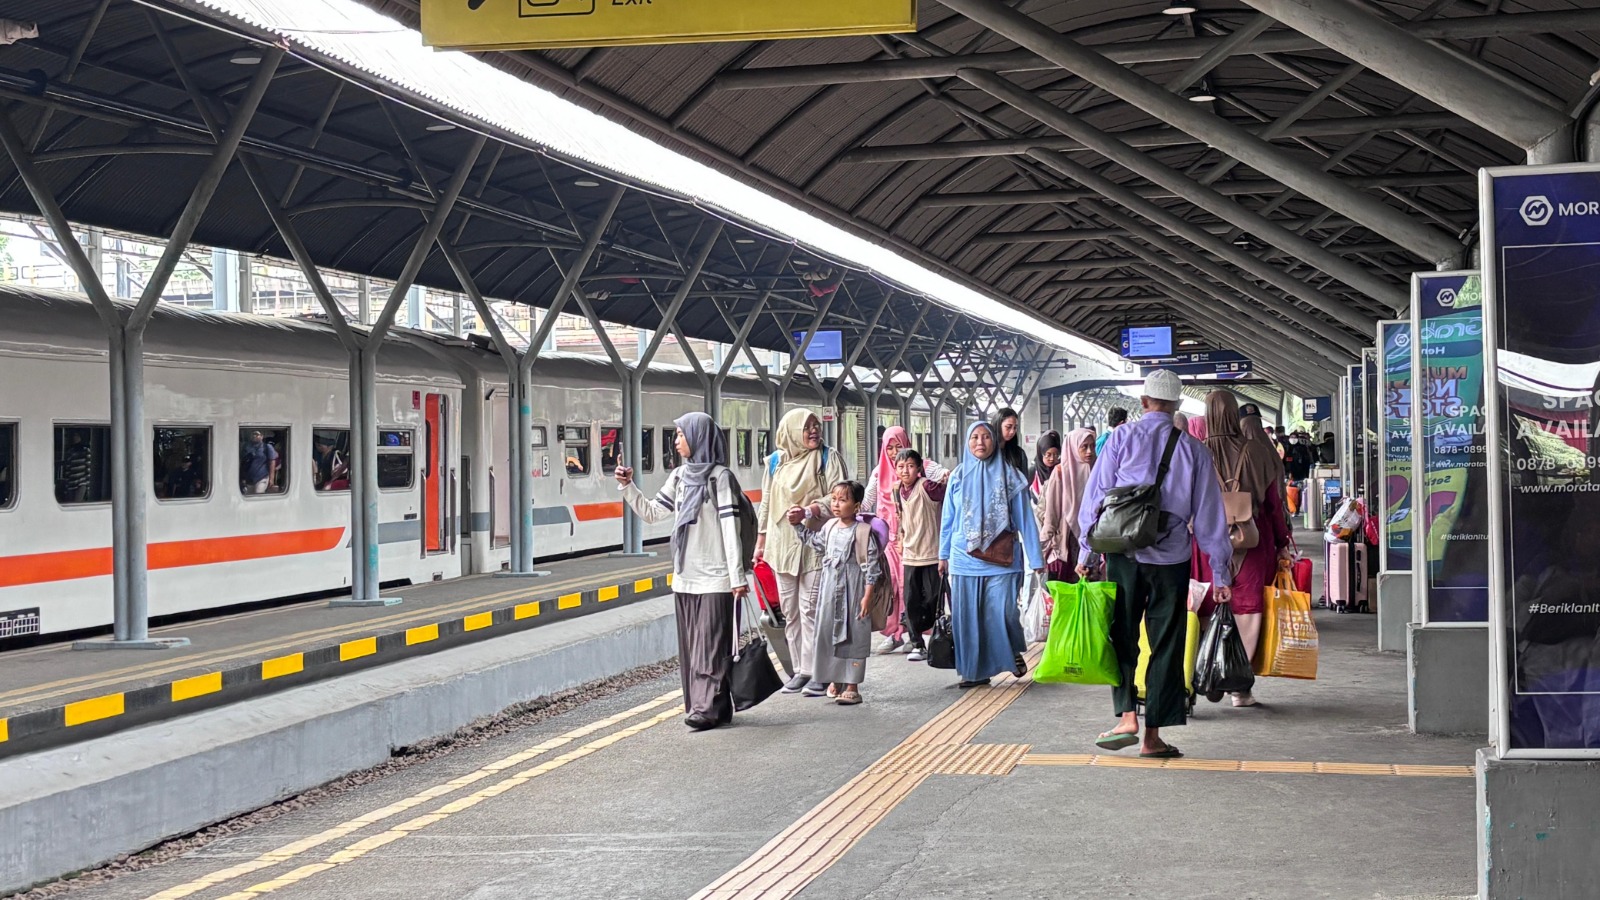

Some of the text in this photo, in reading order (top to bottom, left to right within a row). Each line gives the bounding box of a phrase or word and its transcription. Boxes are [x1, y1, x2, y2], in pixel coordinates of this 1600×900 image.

[1558, 201, 1600, 216] MOR
[1461, 291, 1482, 301] MO
[1516, 456, 1600, 471] 0878089
